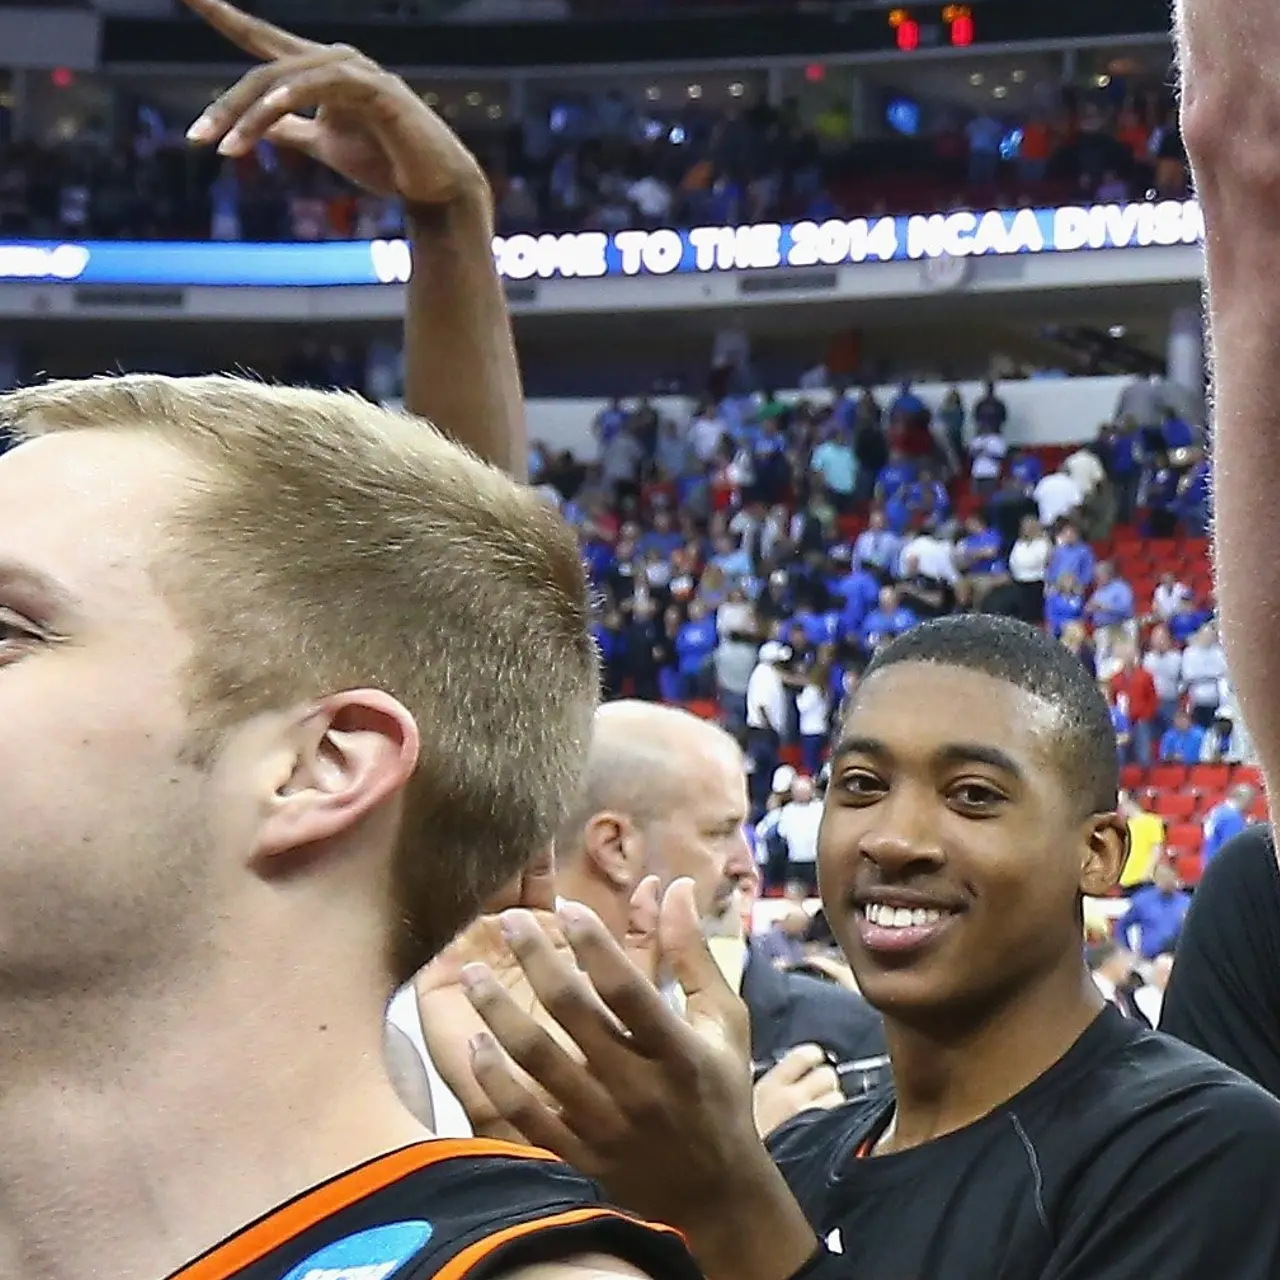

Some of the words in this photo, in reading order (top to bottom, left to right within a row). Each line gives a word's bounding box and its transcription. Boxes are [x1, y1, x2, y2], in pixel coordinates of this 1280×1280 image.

[615, 230, 683, 275] TO
[689, 224, 781, 272] THE
[789, 217, 899, 267] 2014
[906, 209, 1045, 259] NCAA
